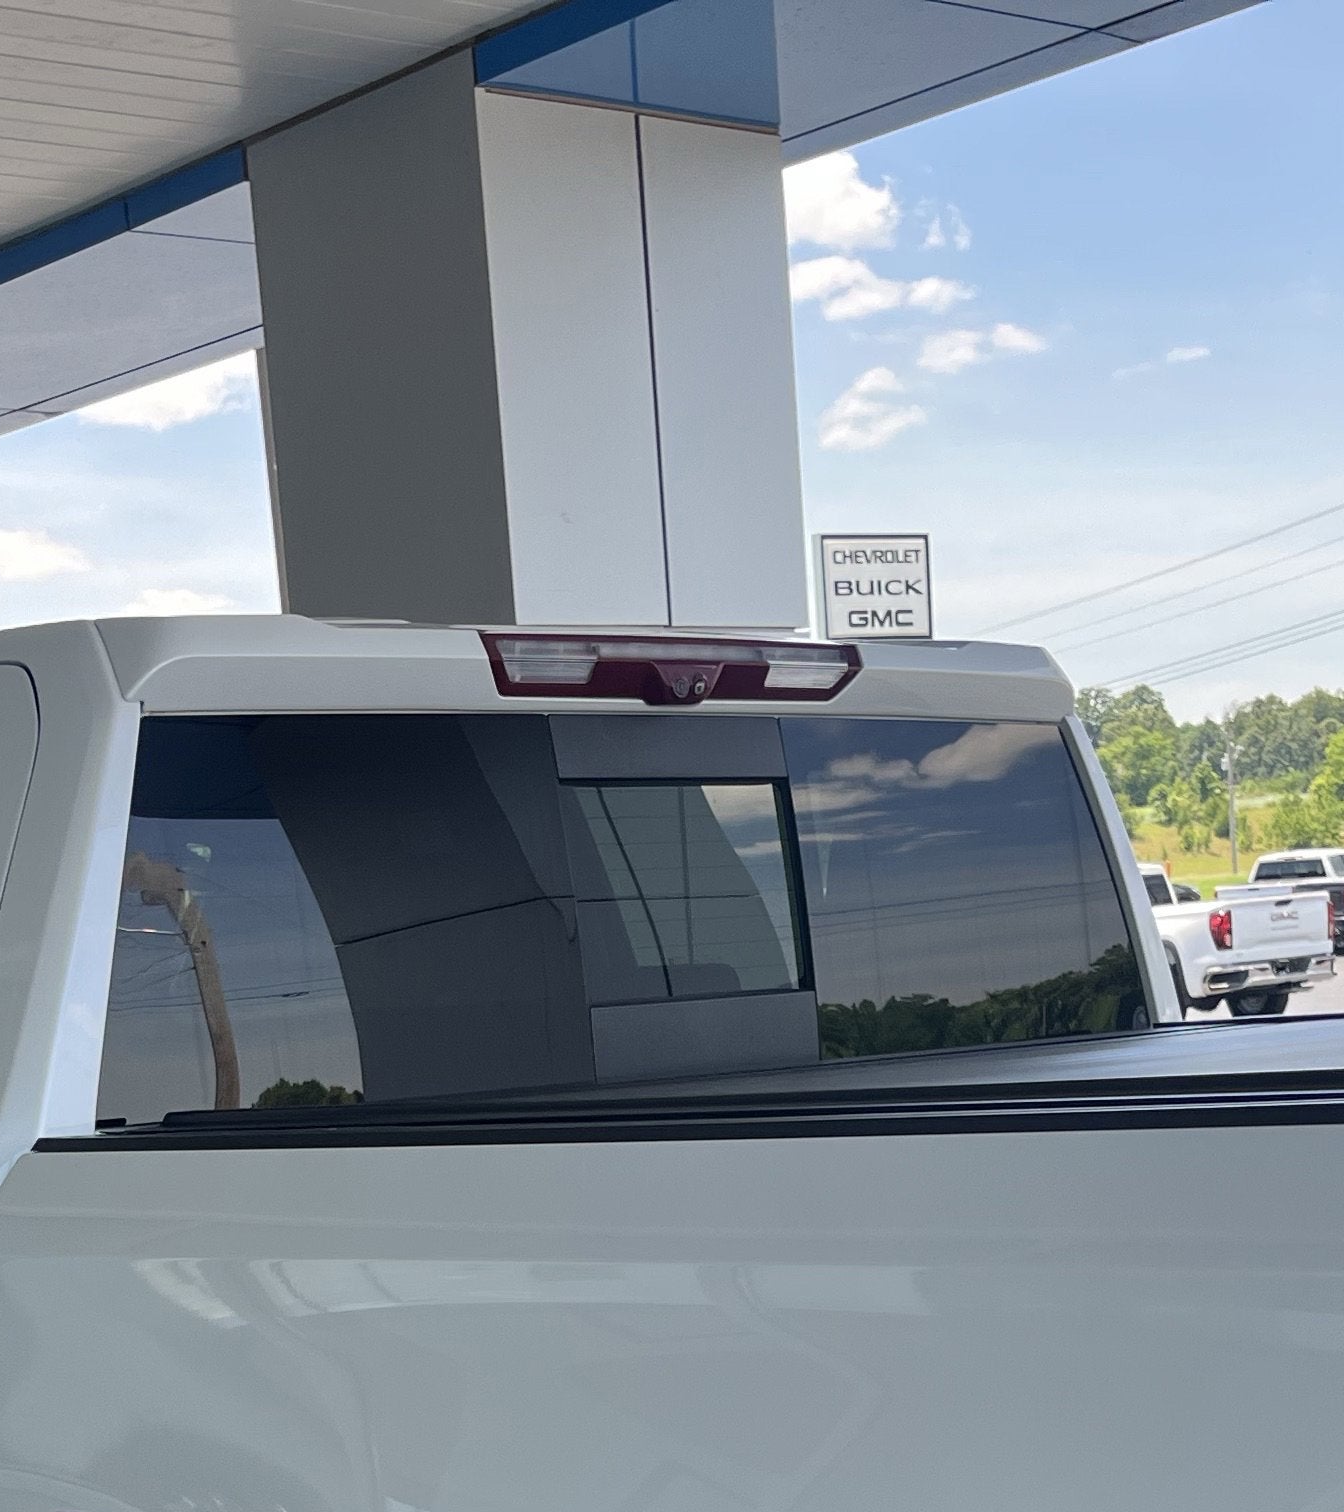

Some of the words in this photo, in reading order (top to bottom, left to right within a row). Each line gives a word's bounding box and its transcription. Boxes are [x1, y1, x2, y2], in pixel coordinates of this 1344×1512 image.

[833, 550, 921, 564] CHEVROLET
[834, 579, 924, 596] BUICK
[848, 610, 914, 627] GMC
